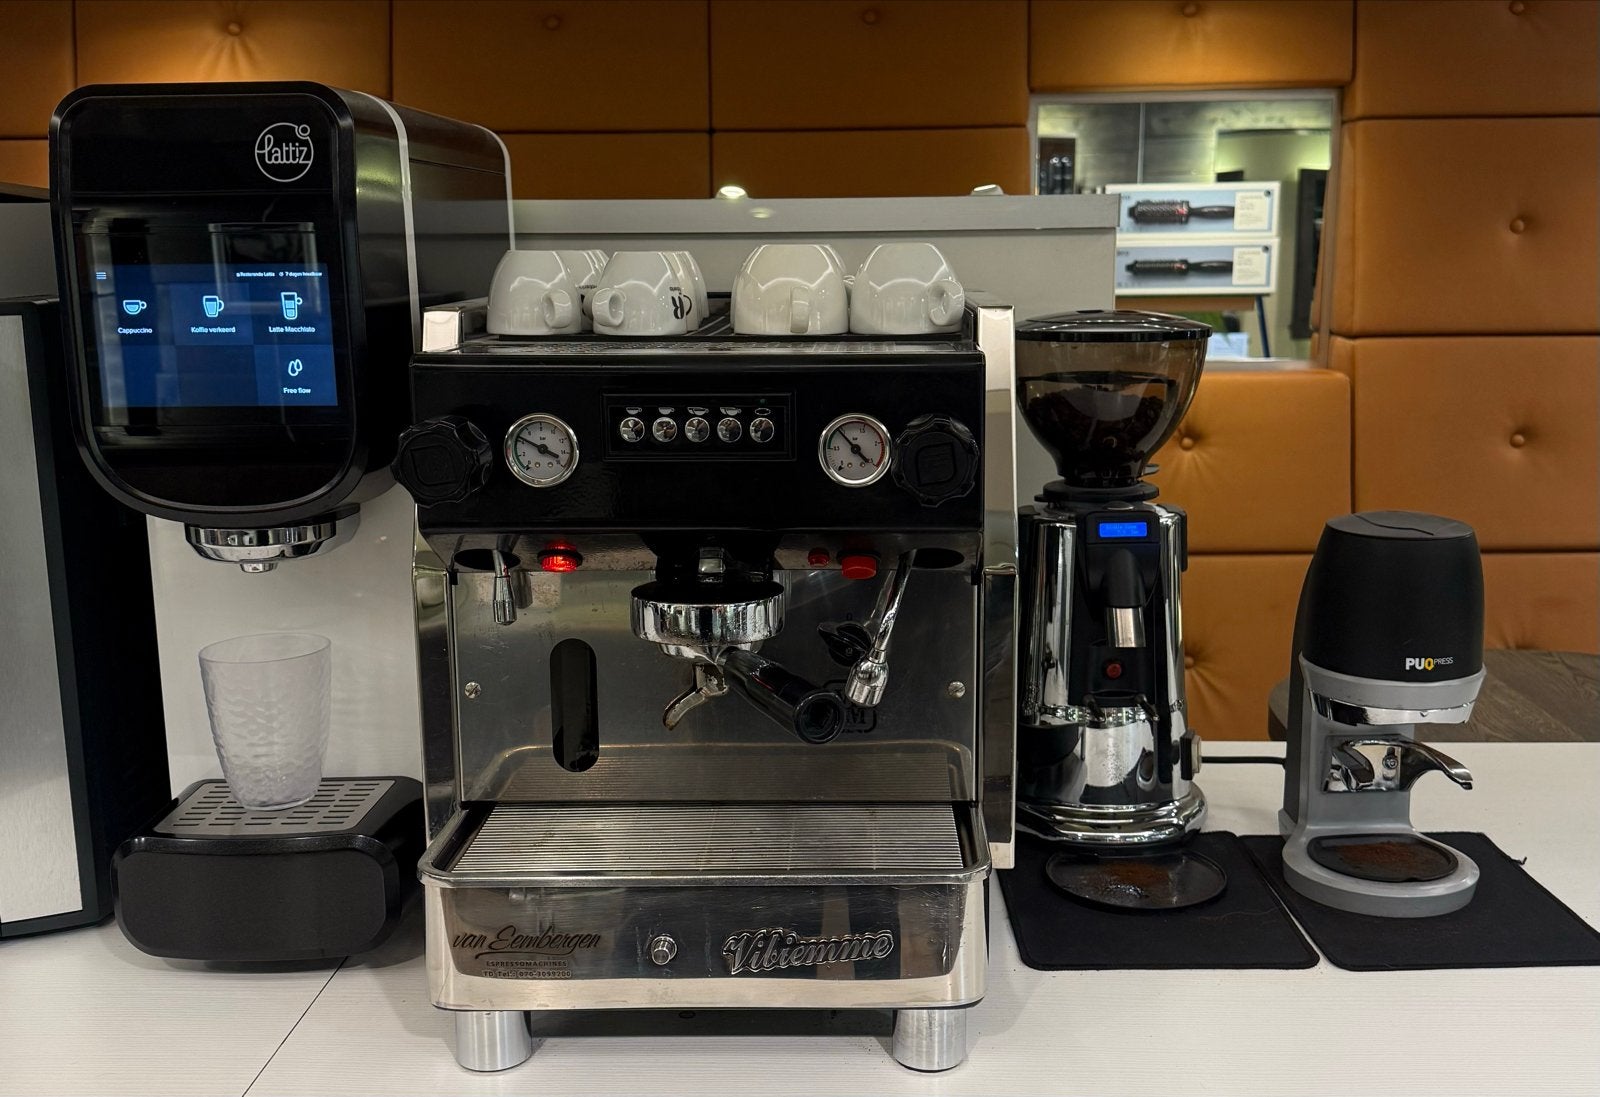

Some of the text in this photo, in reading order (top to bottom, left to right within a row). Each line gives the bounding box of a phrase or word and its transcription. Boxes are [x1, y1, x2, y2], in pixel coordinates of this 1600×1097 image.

[118, 327, 153, 335] Cappuccino
[452, 925, 601, 956] van Eembergen
[723, 928, 894, 975] Vibiemme
